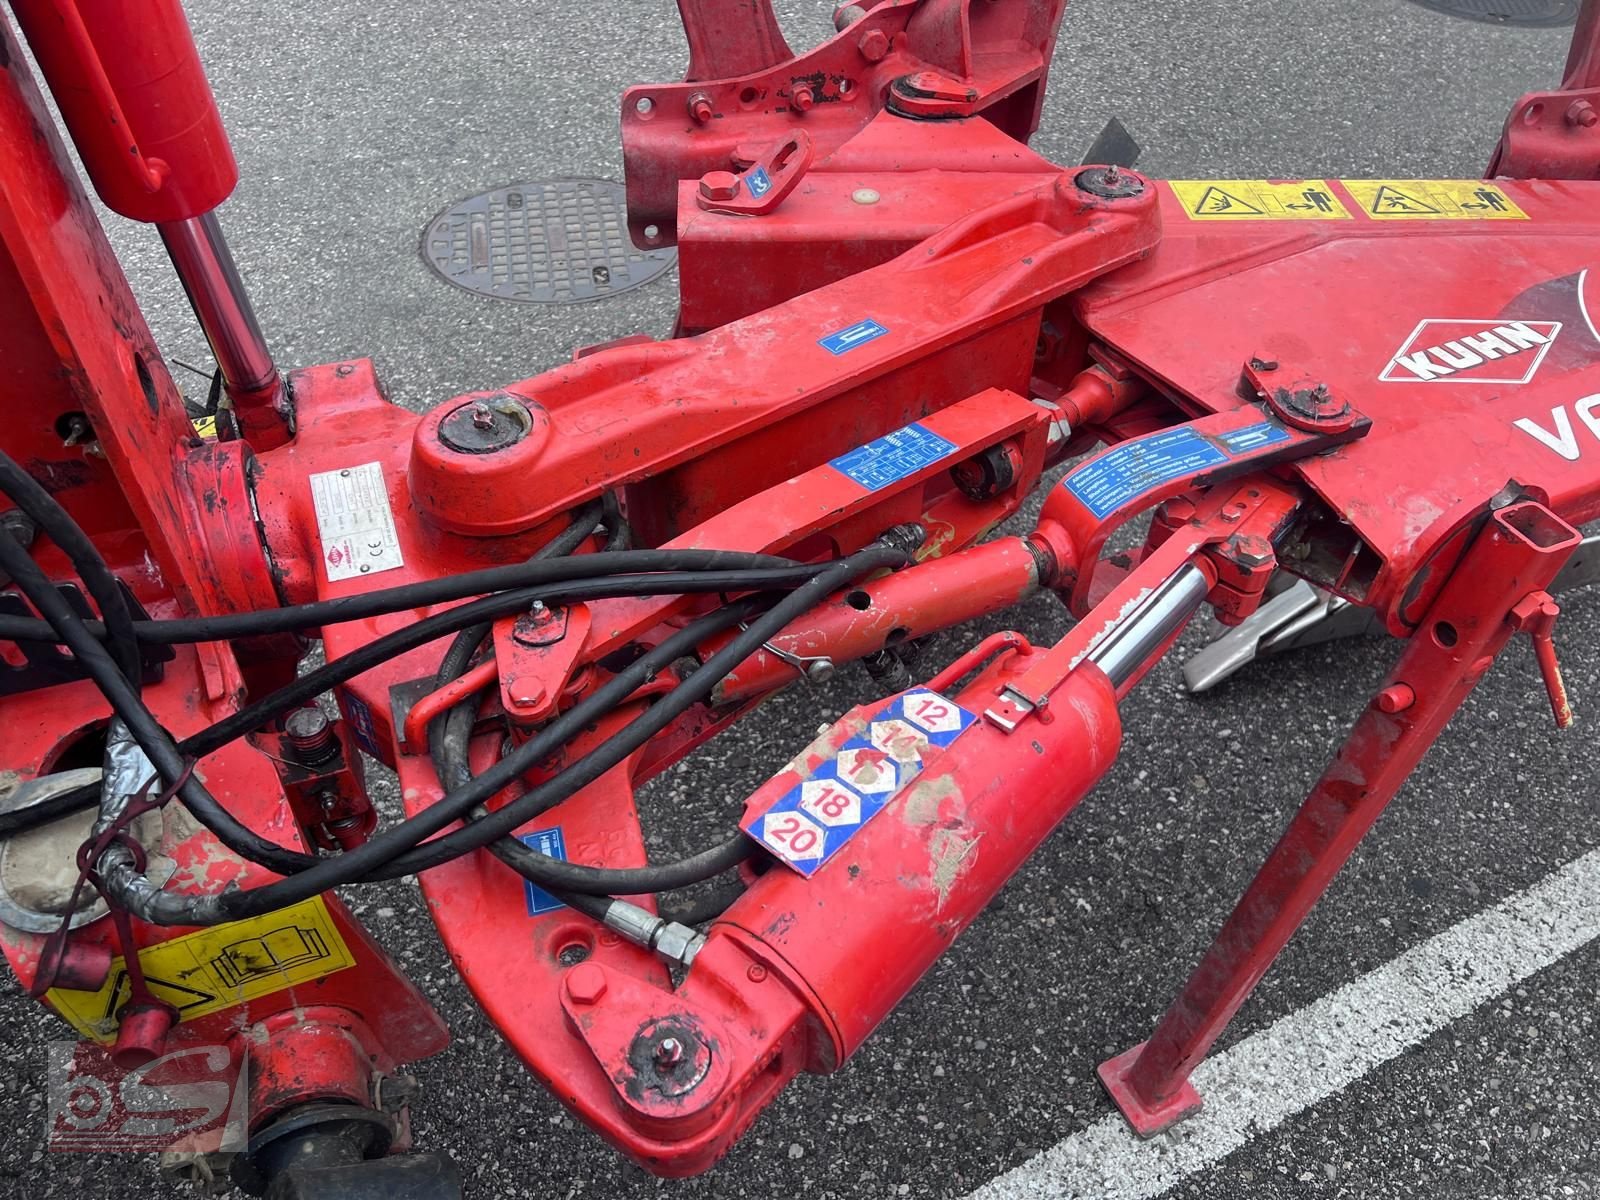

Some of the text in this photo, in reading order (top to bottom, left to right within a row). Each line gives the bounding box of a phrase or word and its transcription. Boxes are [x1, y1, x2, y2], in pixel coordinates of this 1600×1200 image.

[1394, 321, 1551, 380] KUHN
[915, 699, 949, 726] 12
[813, 787, 850, 818] 18
[771, 817, 818, 853] 20
